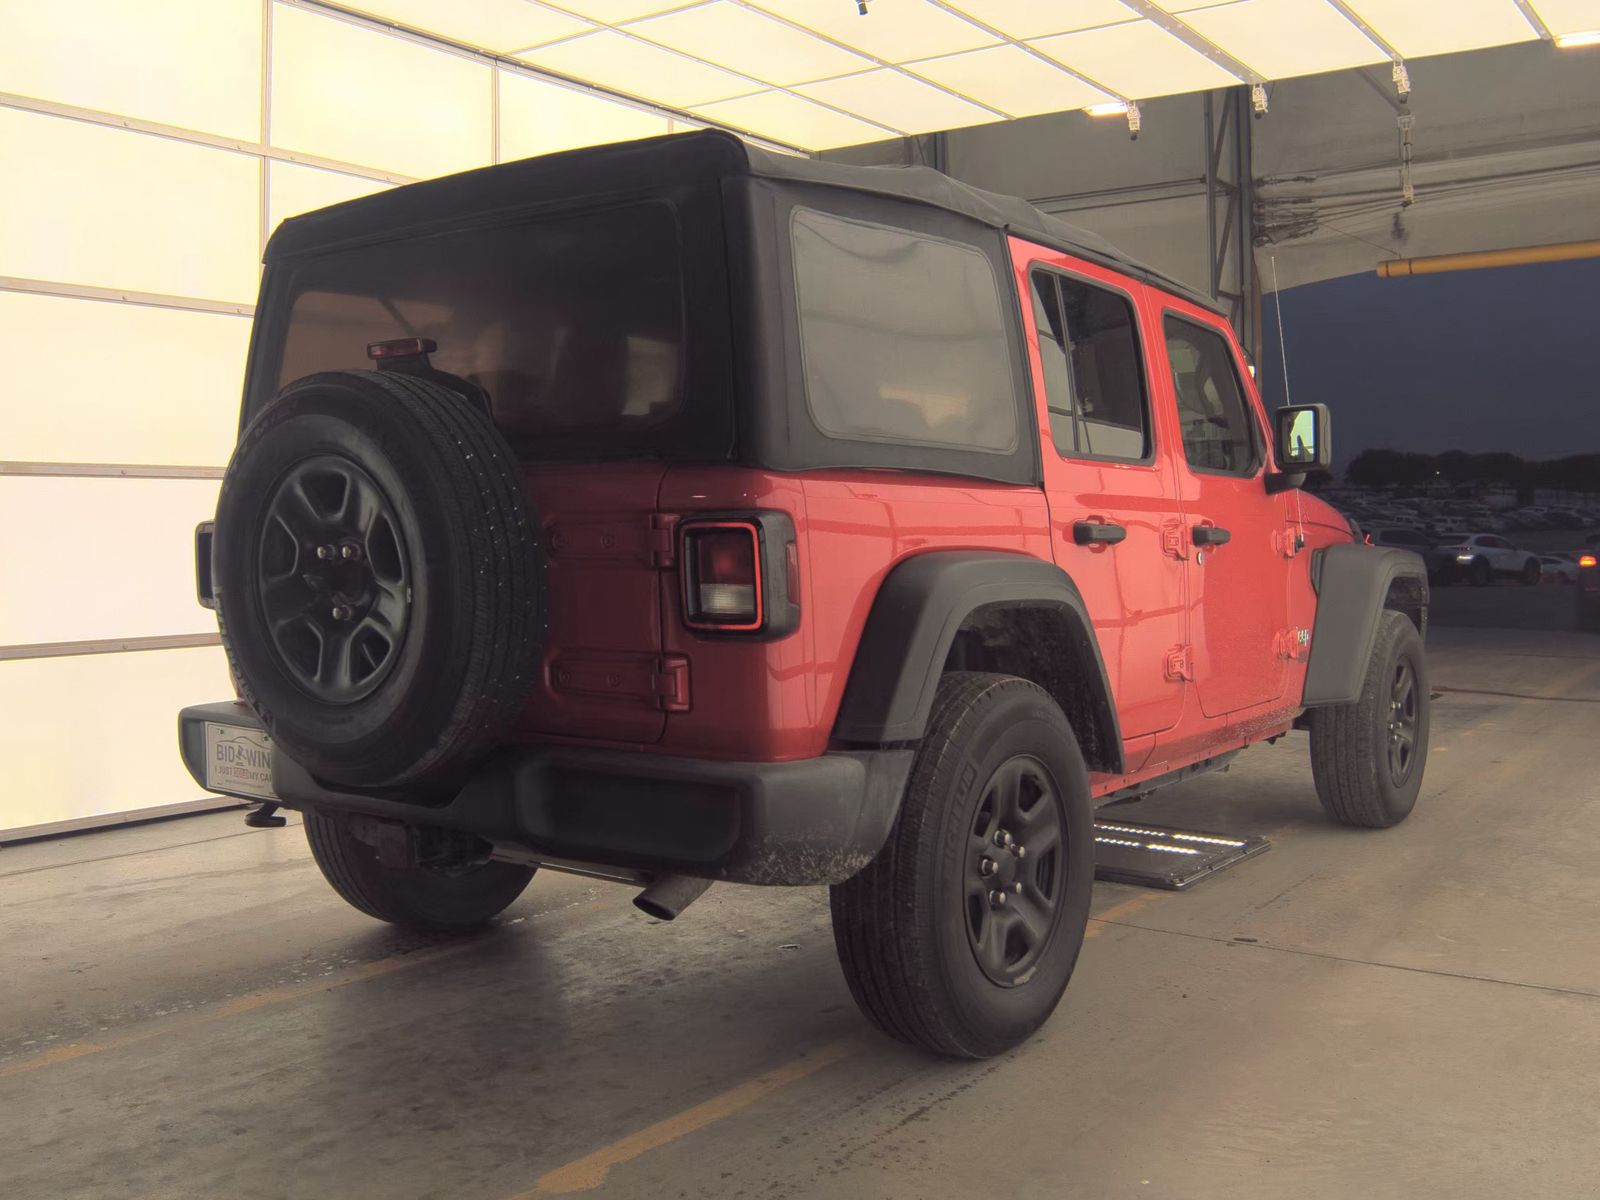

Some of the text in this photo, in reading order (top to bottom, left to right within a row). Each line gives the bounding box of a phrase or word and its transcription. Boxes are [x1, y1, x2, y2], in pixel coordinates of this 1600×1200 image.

[216, 744, 271, 769] BID WIN
[249, 772, 259, 781] MY
